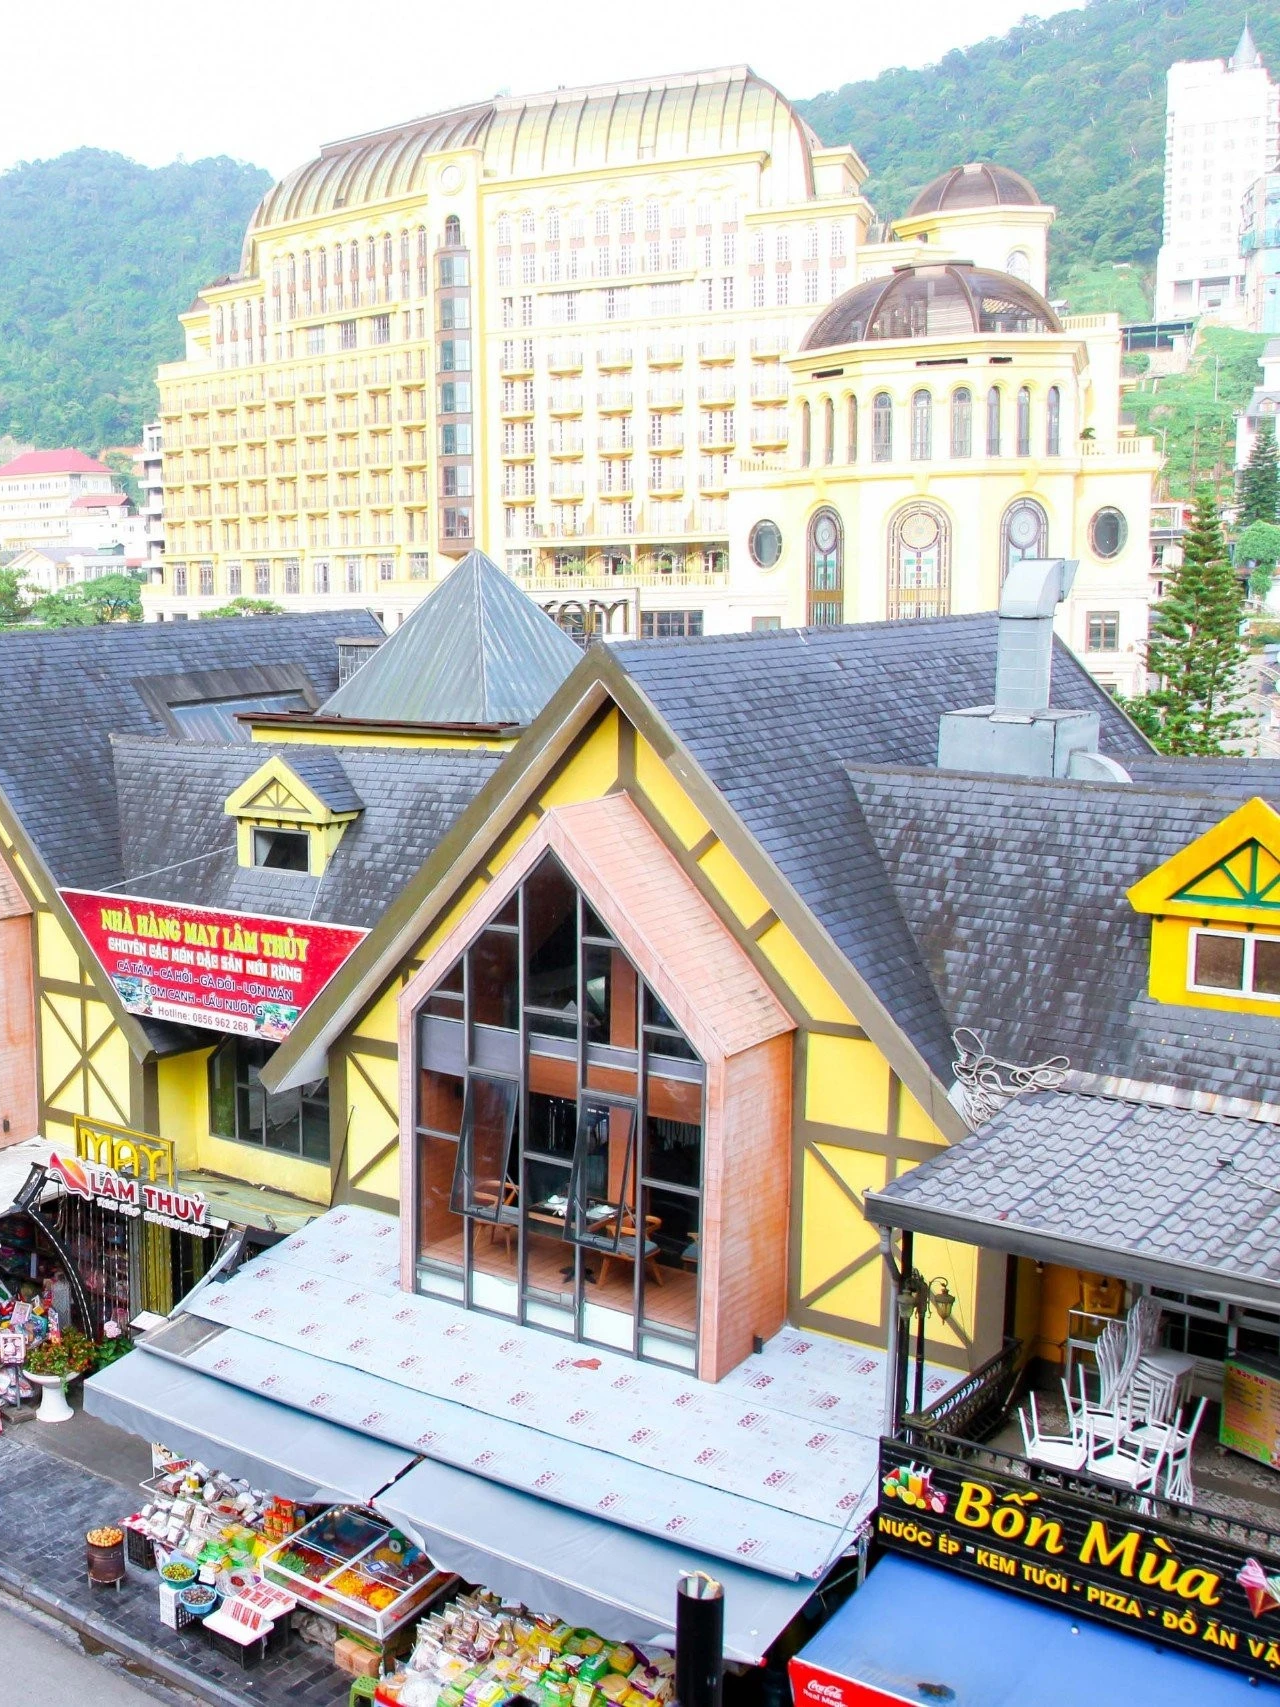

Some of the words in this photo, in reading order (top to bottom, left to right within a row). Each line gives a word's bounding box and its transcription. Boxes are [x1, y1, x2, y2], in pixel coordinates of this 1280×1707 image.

[101, 906, 134, 935] NHÀ
[137, 910, 181, 942] HÀNG
[183, 922, 220, 948] MAY
[222, 923, 259, 954] LÂM
[108, 936, 148, 956] CHUYÊN
[149, 942, 169, 960] CÁC
[171, 945, 195, 966] MÓN
[197, 950, 219, 971] ĐẶC
[167, 989, 196, 1004] CANH
[157, 1005, 191, 1022] Hotline:
[192, 1013, 213, 1025] 0856
[214, 1016, 231, 1028] 962
[232, 1019, 249, 1032] 268
[79, 1126, 165, 1182] MAY
[90, 1171, 135, 1203] LÂM
[954, 1481, 1065, 1555] Bốn
[1078, 1520, 1221, 1605] Mùa
[878, 1516, 933, 1547] NƯỚC
[938, 1533, 960, 1555] ÉP
[976, 1549, 1017, 1576] KEM
[1022, 1564, 1069, 1594] TƯƠI
[1087, 1586, 1142, 1618] PIZZA
[1162, 1609, 1198, 1635] ĐỒ
[1202, 1619, 1237, 1650] ĂN
[807, 1679, 844, 1699] Coca-Cola
